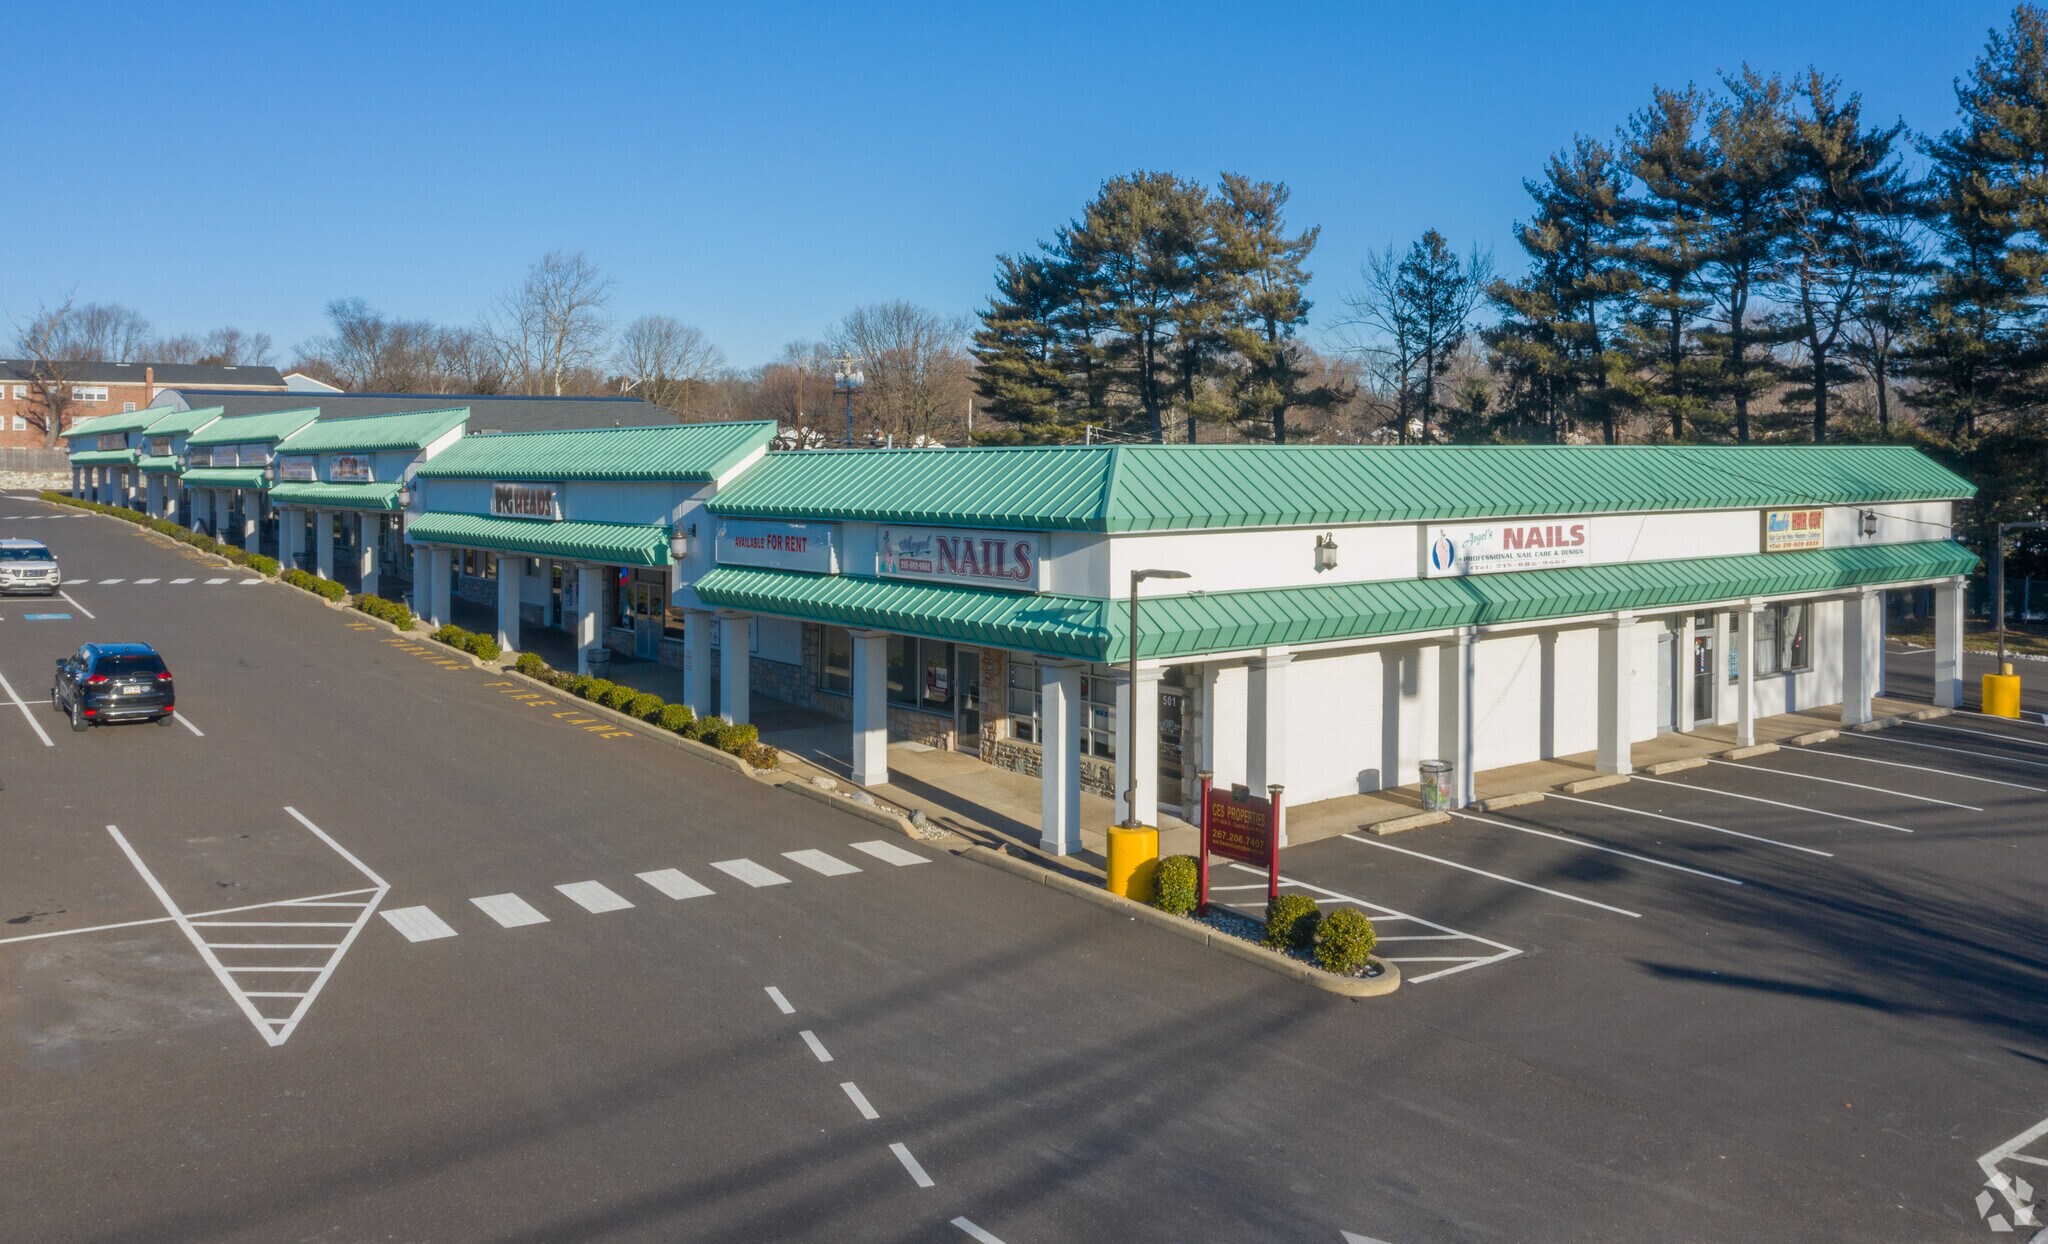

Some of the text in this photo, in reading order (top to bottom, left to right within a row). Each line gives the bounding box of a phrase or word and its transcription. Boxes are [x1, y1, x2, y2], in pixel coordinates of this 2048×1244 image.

[514, 486, 552, 516] HEADS
[735, 534, 807, 553] AVAILABLE FOR RENT
[898, 534, 932, 556] Angel
[1462, 528, 1493, 548] Angel's
[1503, 525, 1585, 550] NAILS
[936, 536, 1032, 582] NAILS
[1463, 553, 1513, 563] PROFESSIONAL
[1516, 551, 1532, 559] NAIL
[1535, 550, 1551, 558] CARE
[380, 638, 470, 670] PARKING
[483, 681, 557, 707] FIRE
[552, 711, 634, 739] LANE
[1162, 695, 1176, 707] 501
[1212, 803, 1266, 827] CES PROPERTIES
[1212, 829, 1265, 849] 267.206.7407
